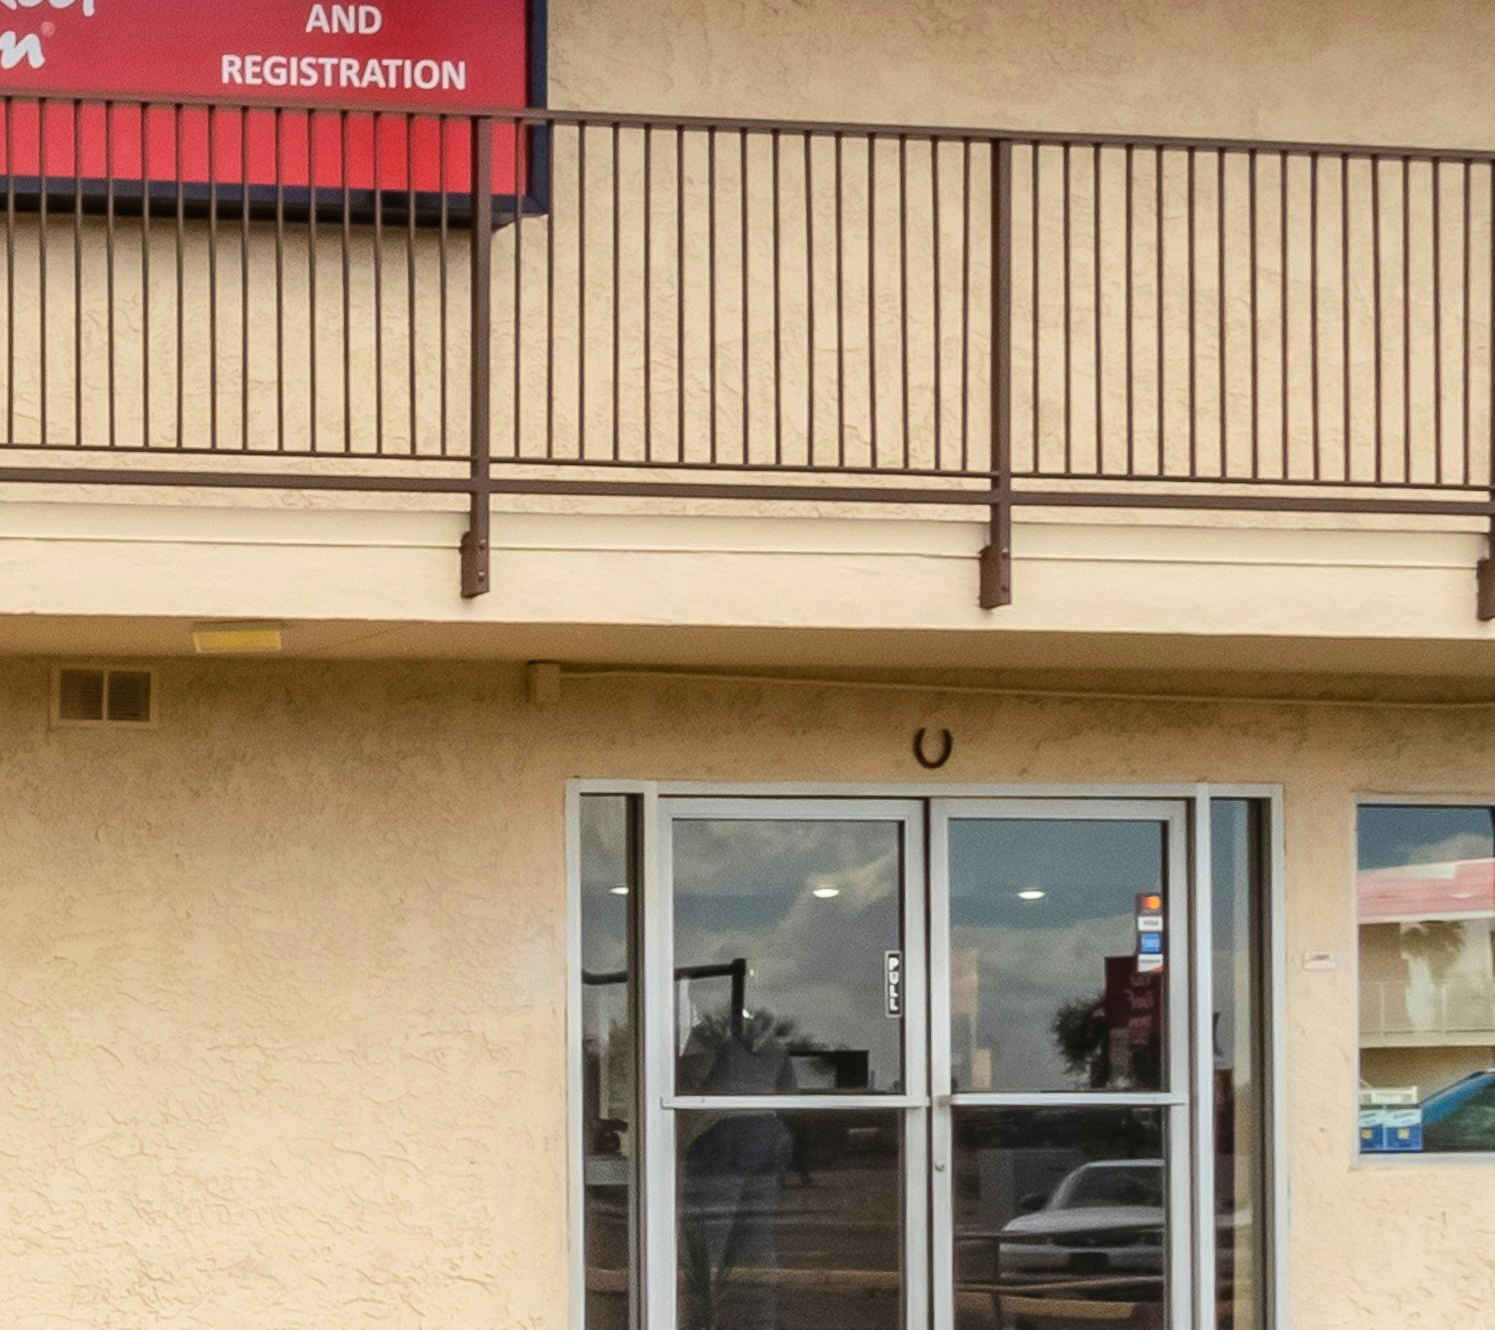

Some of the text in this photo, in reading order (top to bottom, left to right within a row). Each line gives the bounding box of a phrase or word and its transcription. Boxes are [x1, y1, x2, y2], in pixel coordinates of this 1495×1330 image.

[305, 3, 383, 36] AND
[220, 53, 467, 91] REGISTRATION
[888, 956, 900, 1012] PULL
